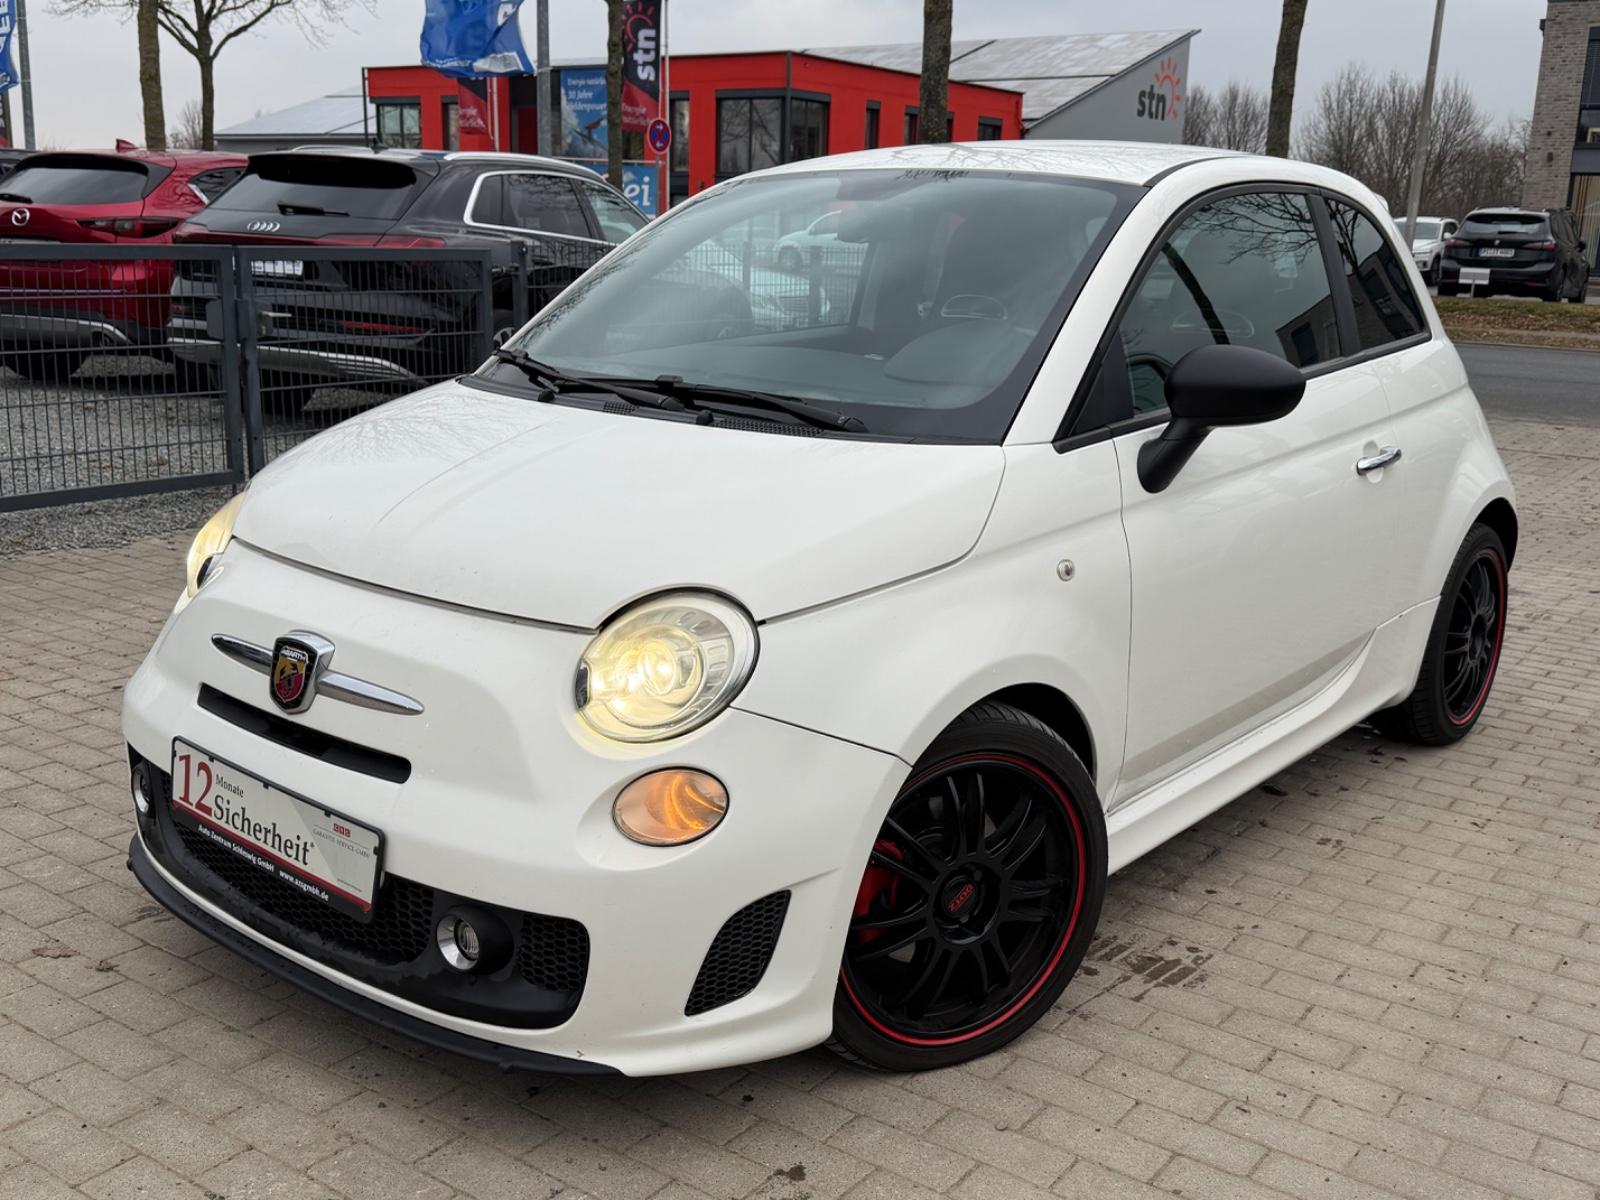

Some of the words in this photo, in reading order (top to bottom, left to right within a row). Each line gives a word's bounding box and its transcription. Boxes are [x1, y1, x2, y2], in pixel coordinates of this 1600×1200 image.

[633, 28, 656, 82] stn
[1137, 84, 1167, 121] stn
[178, 754, 213, 817] 12
[215, 774, 244, 798] Monate
[198, 824, 211, 837] Auto
[211, 830, 232, 848] Zentrum
[232, 842, 257, 864] Schleswig
[257, 857, 275, 872] GmbH
